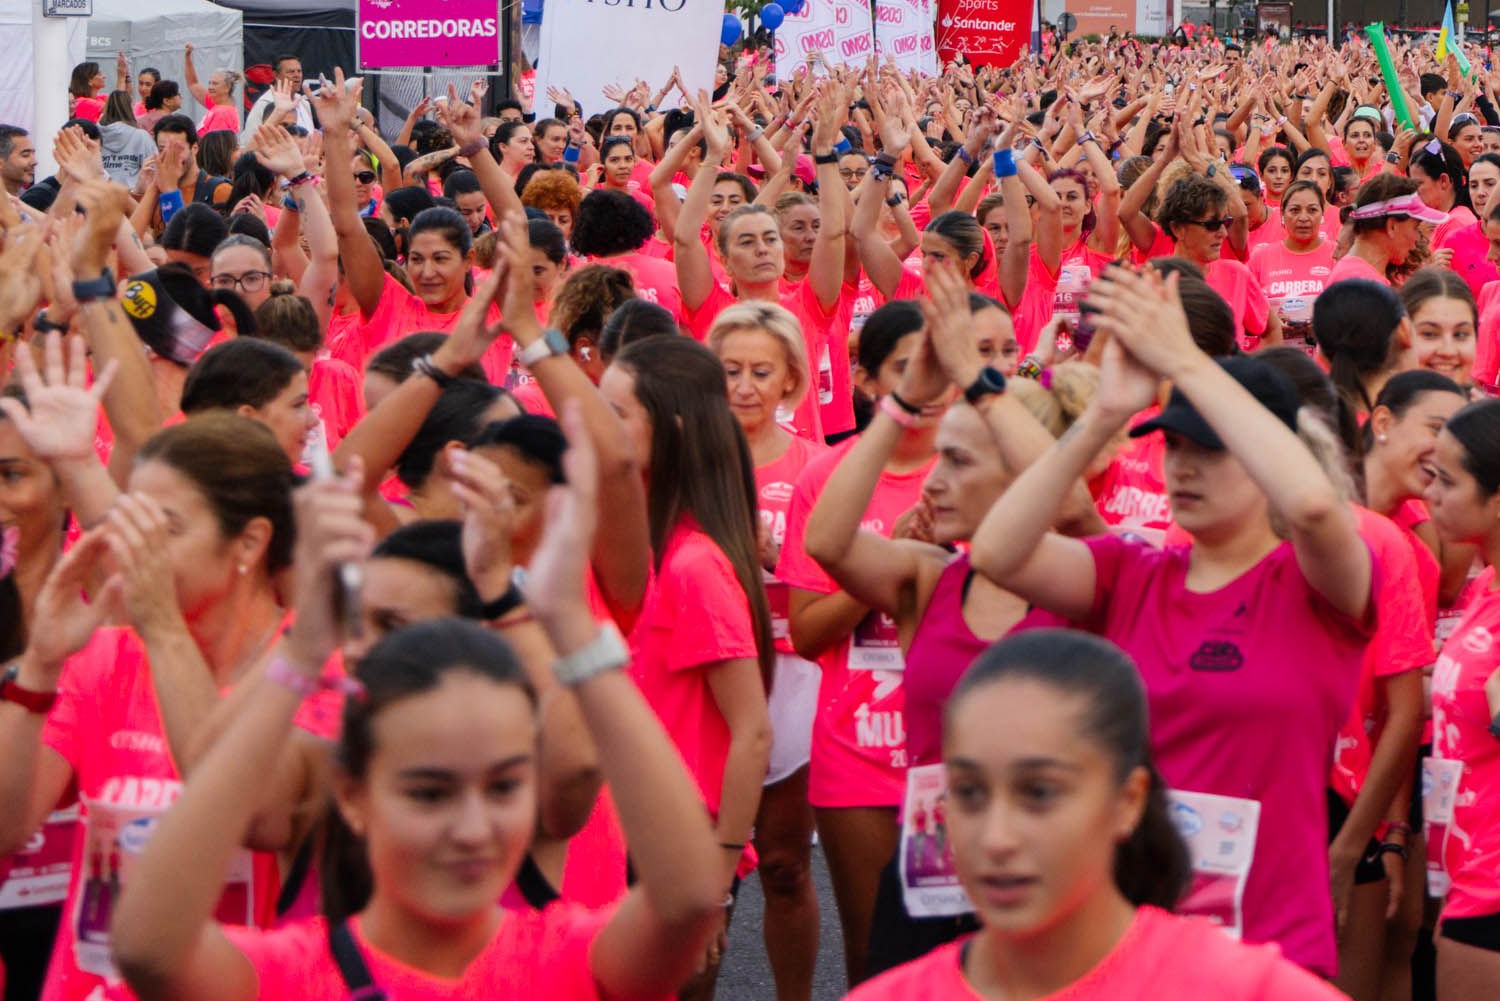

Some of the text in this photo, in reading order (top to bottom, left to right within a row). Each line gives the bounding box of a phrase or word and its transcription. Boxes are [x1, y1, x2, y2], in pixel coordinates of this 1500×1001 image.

[52, 0, 87, 9] MARCADOS
[362, 18, 496, 39] CORREDORAS
[954, 16, 1016, 31] Santander
[90, 37, 112, 47] BCS
[1270, 280, 1324, 295] CARRERA
